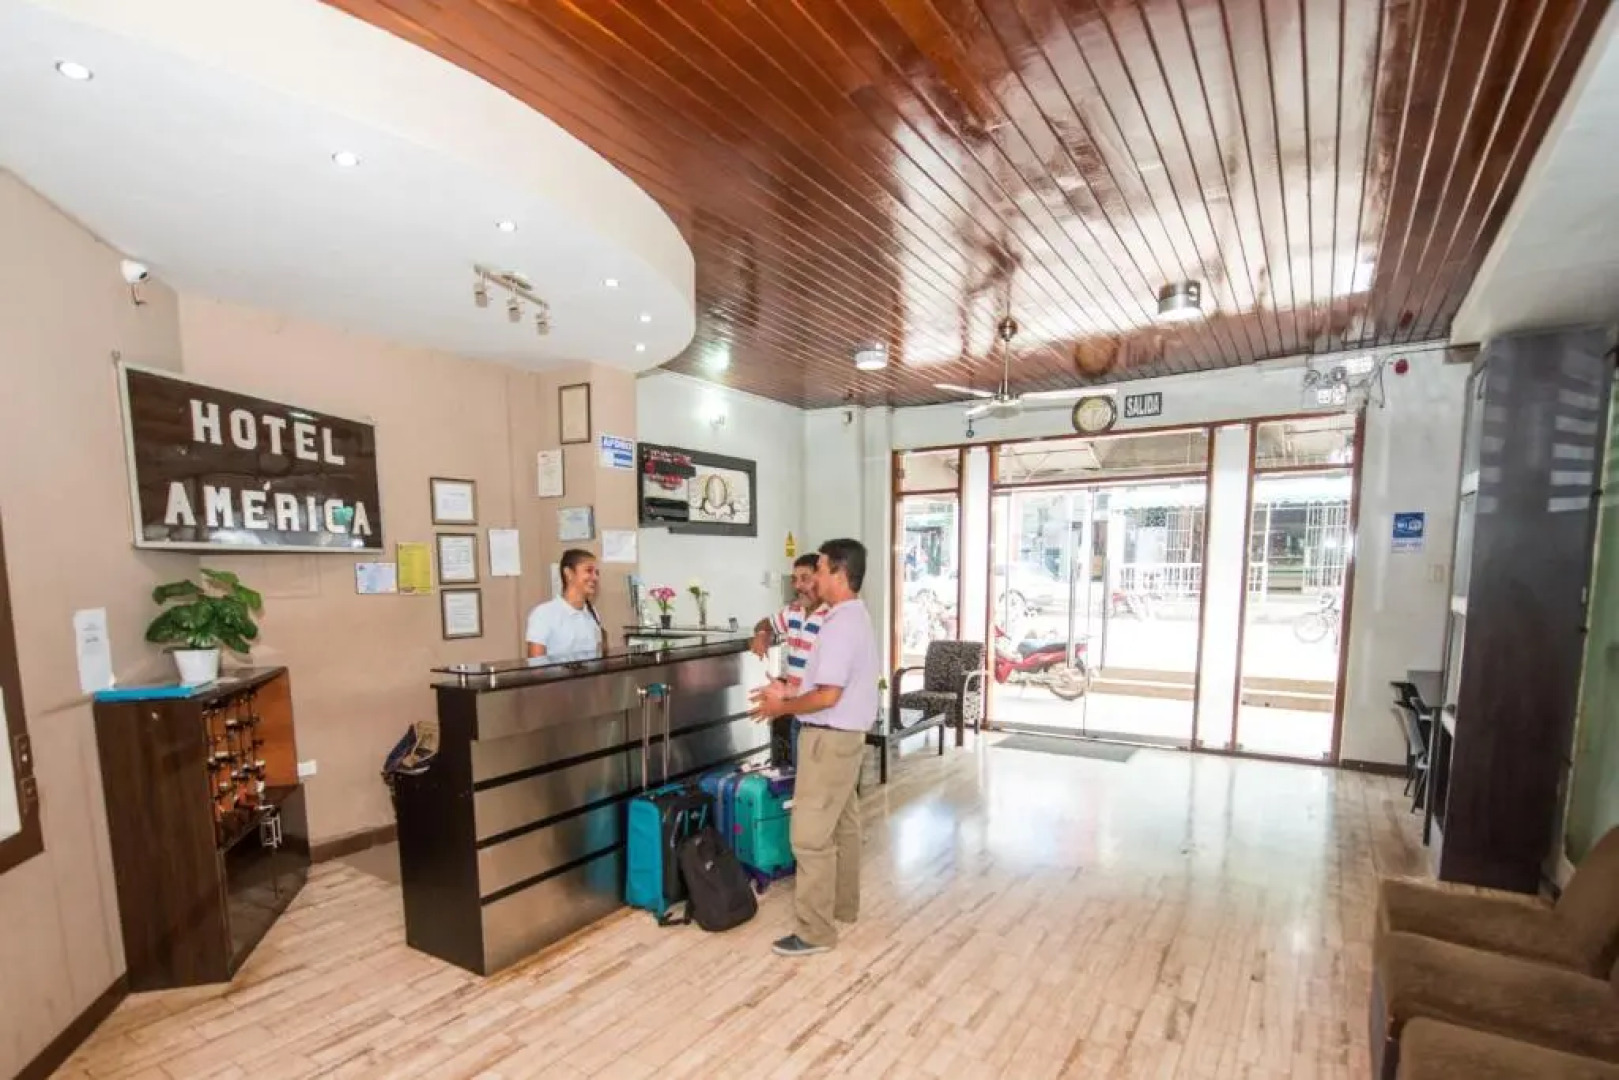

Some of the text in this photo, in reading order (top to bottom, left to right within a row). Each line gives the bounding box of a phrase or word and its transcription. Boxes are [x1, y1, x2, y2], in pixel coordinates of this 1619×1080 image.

[189, 399, 346, 466] HOTEL
[1127, 394, 1160, 416] SALIDA
[164, 480, 372, 536] AMÉRICA
